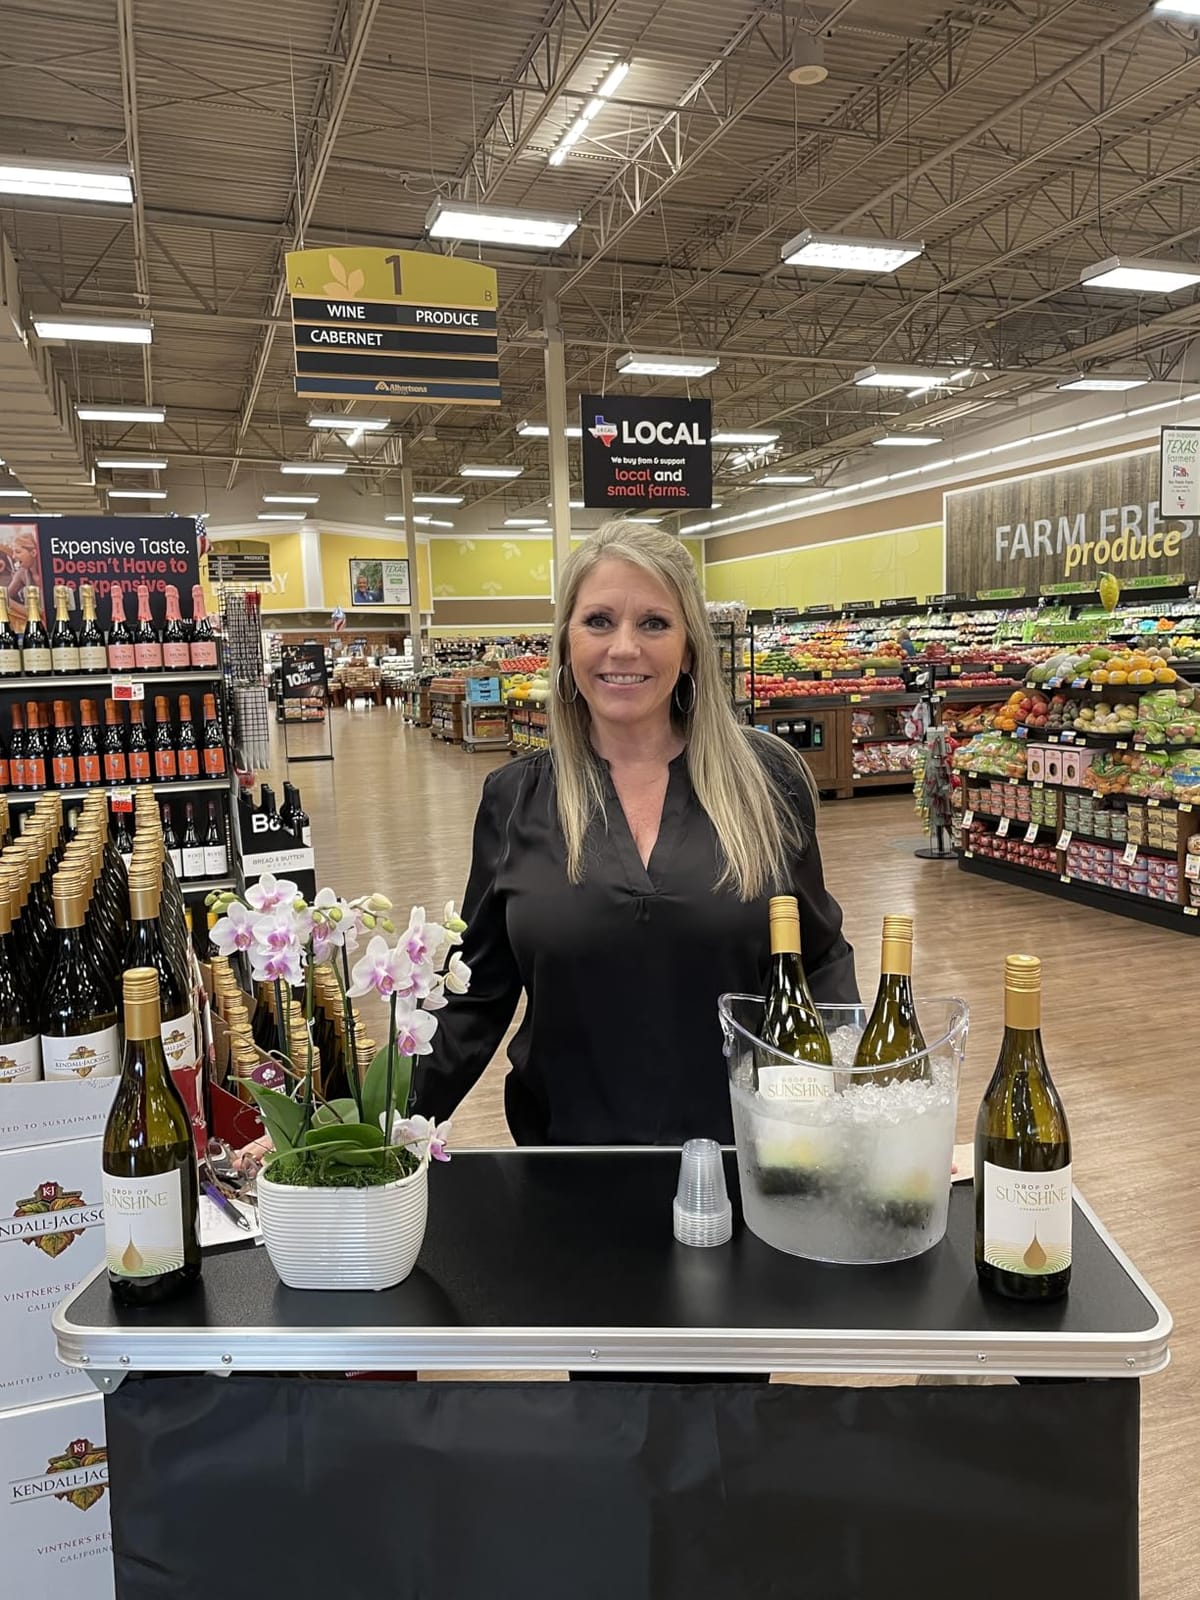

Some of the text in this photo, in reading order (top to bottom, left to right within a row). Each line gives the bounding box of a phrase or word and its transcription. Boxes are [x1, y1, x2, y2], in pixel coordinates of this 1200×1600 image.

[385, 254, 403, 295] 1
[295, 277, 305, 289] A
[484, 290, 493, 302] B
[326, 304, 366, 319] WINE
[416, 310, 480, 326] PRODUCE
[310, 329, 384, 346] CABERNET
[622, 420, 707, 446] LOCAL
[1166, 440, 1199, 454] TEXAS
[611, 456, 622, 464] We
[623, 457, 637, 466] buy
[638, 457, 653, 466] from
[660, 457, 686, 466] support
[615, 468, 682, 482] local and
[607, 484, 690, 499] small farms.
[995, 513, 1086, 562] FARM
[51, 537, 190, 559] Expensive Taste.
[1064, 527, 1182, 577] produce
[53, 558, 188, 574] Doesn't Have to
[1055, 629, 1090, 639] ORGANIC
[767, 1083, 831, 1098] SUNSHINE
[104, 1191, 168, 1210] SUNSHINE
[996, 1184, 1068, 1206] SUNSHINE
[4, 1284, 61, 1302] VINTNER'S
[37, 1536, 92, 1555] VINTNER'S
